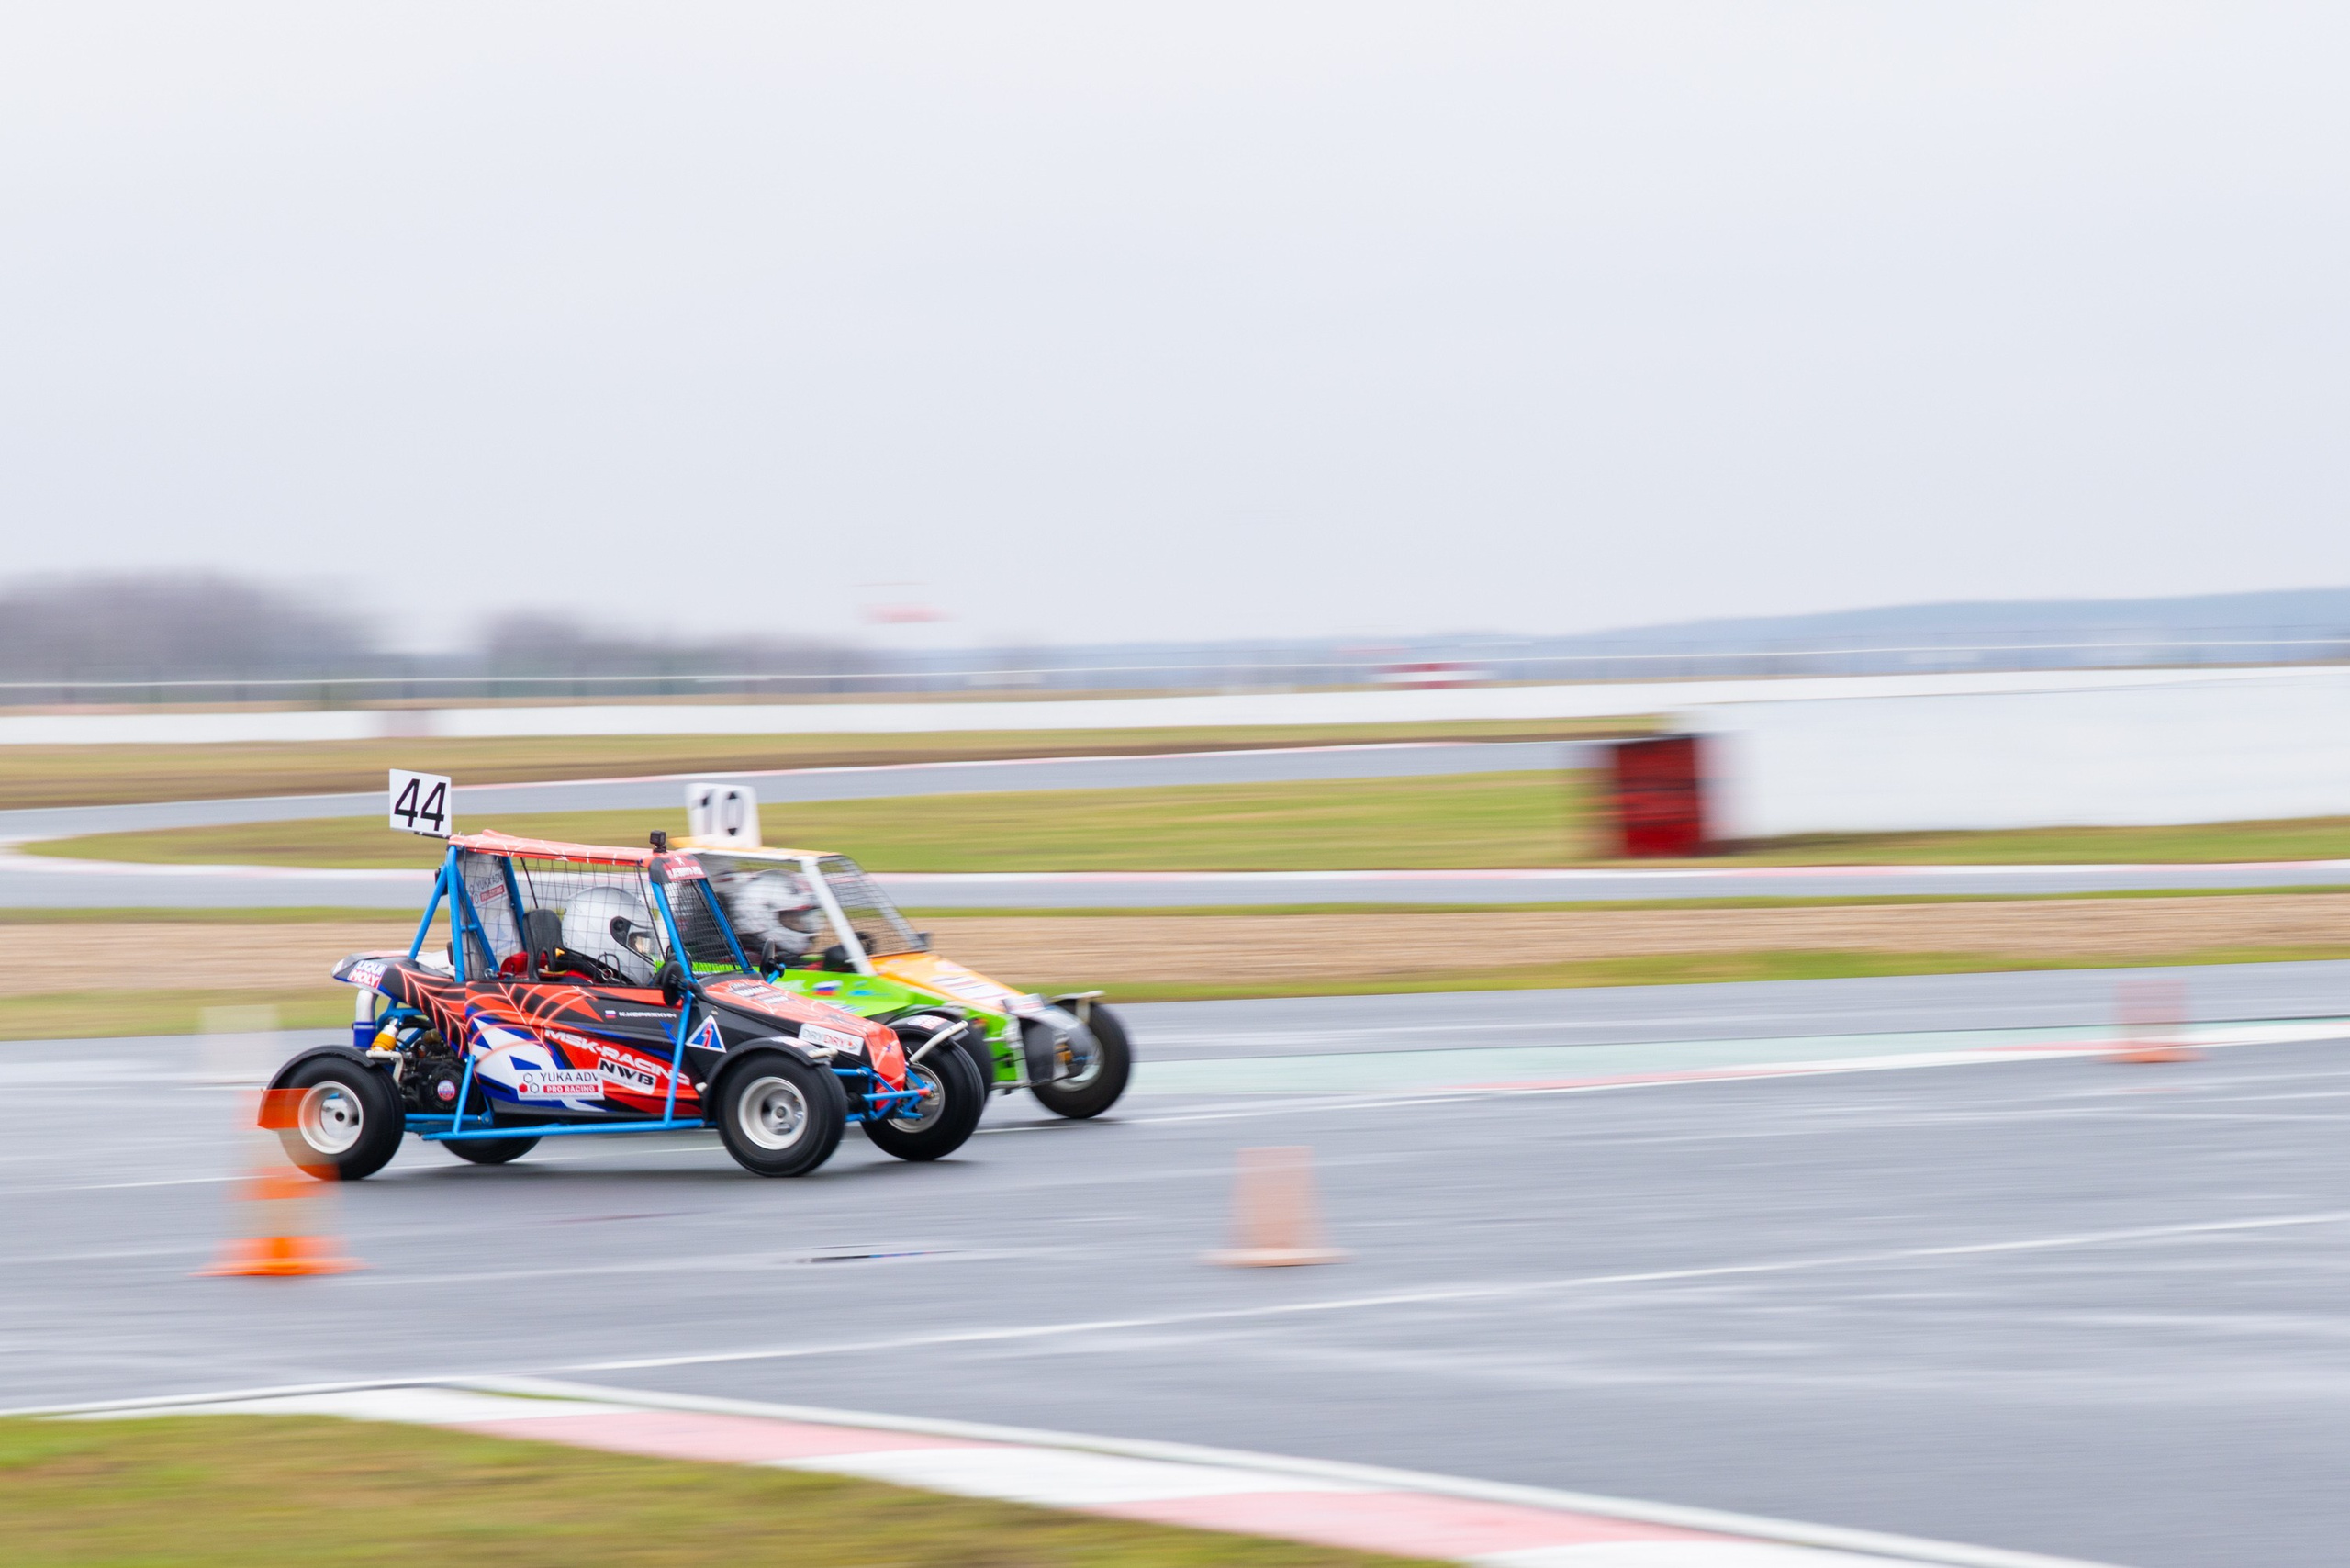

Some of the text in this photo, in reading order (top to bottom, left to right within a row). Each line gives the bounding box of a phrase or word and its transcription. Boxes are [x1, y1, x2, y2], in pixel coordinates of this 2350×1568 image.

[394, 778, 446, 832] 44
[691, 790, 744, 837] 10
[349, 969, 380, 988] MOLY
[355, 960, 386, 977] LIQUI
[544, 1029, 690, 1085] MSK-RACING
[540, 1072, 573, 1082] YUKA
[599, 1060, 654, 1086] NWB
[546, 1085, 595, 1093] PRO RACING
